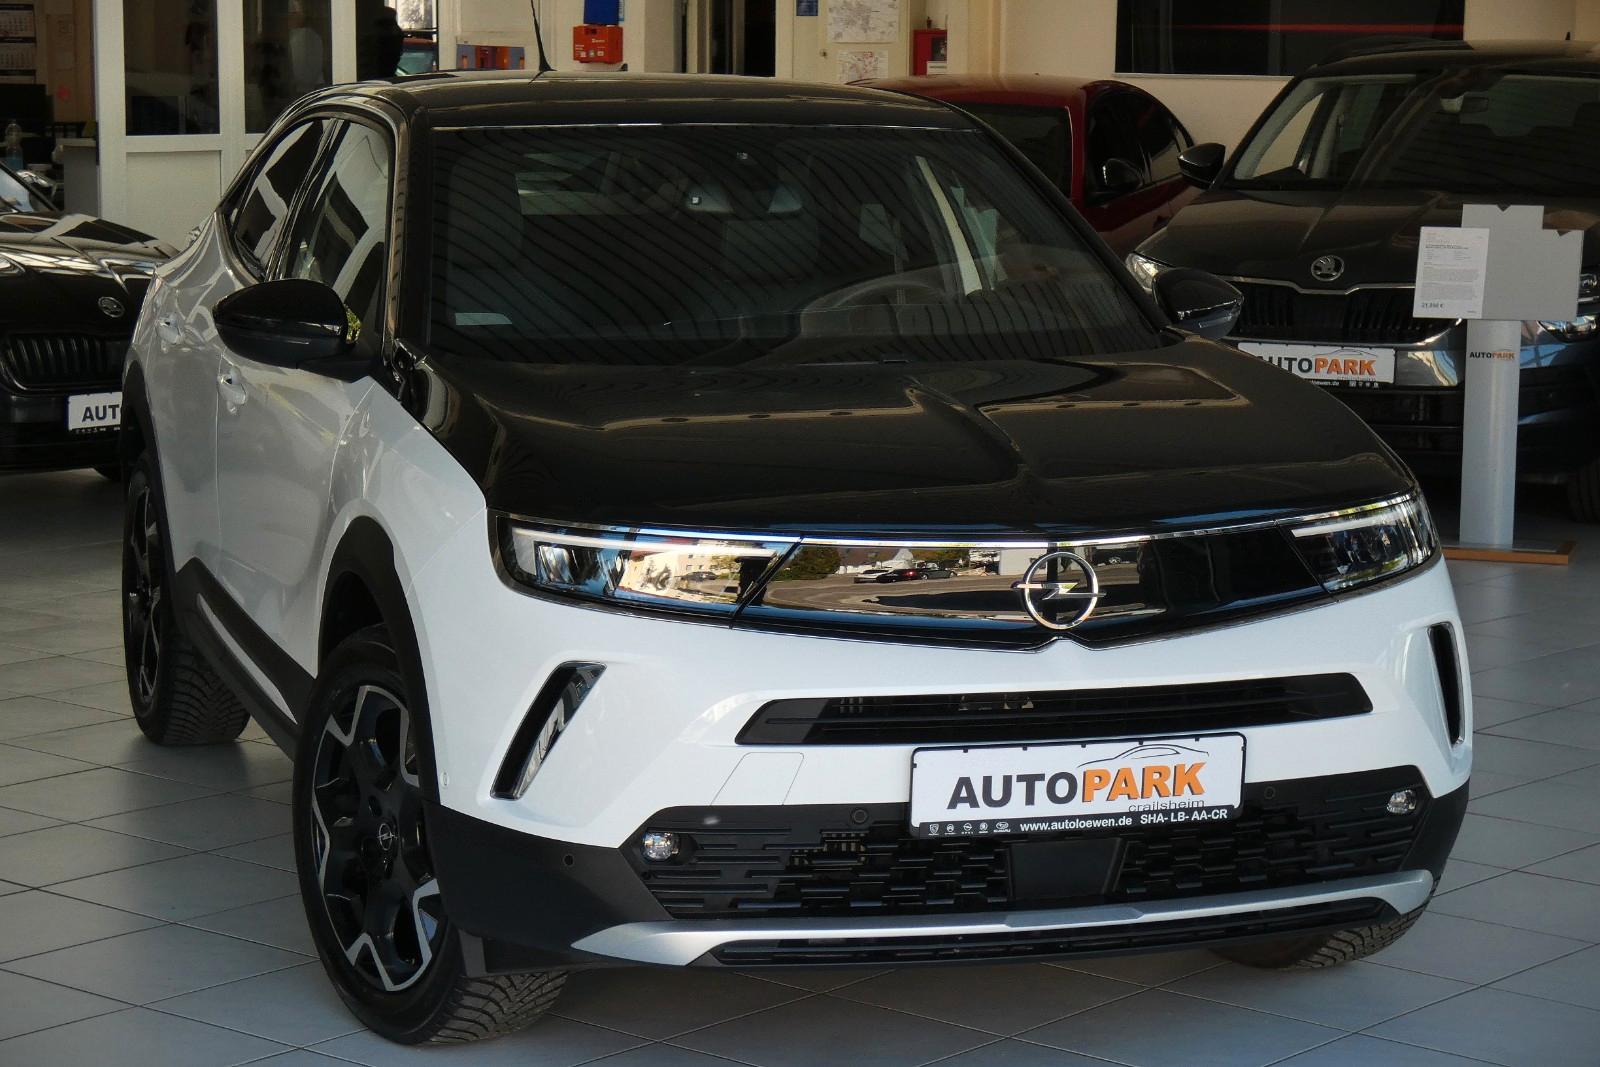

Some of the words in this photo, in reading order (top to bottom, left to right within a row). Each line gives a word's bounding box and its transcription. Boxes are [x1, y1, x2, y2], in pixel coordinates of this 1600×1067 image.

[1257, 355, 1377, 376] UTOPARK
[82, 404, 122, 423] AUT
[946, 761, 1207, 811] AUTOPARK
[1128, 799, 1206, 812] crailsheim
[1020, 815, 1133, 833] www.autoloewen.de
[1140, 811, 1168, 826] SHA-
[1170, 810, 1190, 823] LB-
[1191, 808, 1228, 822] AA-CR
